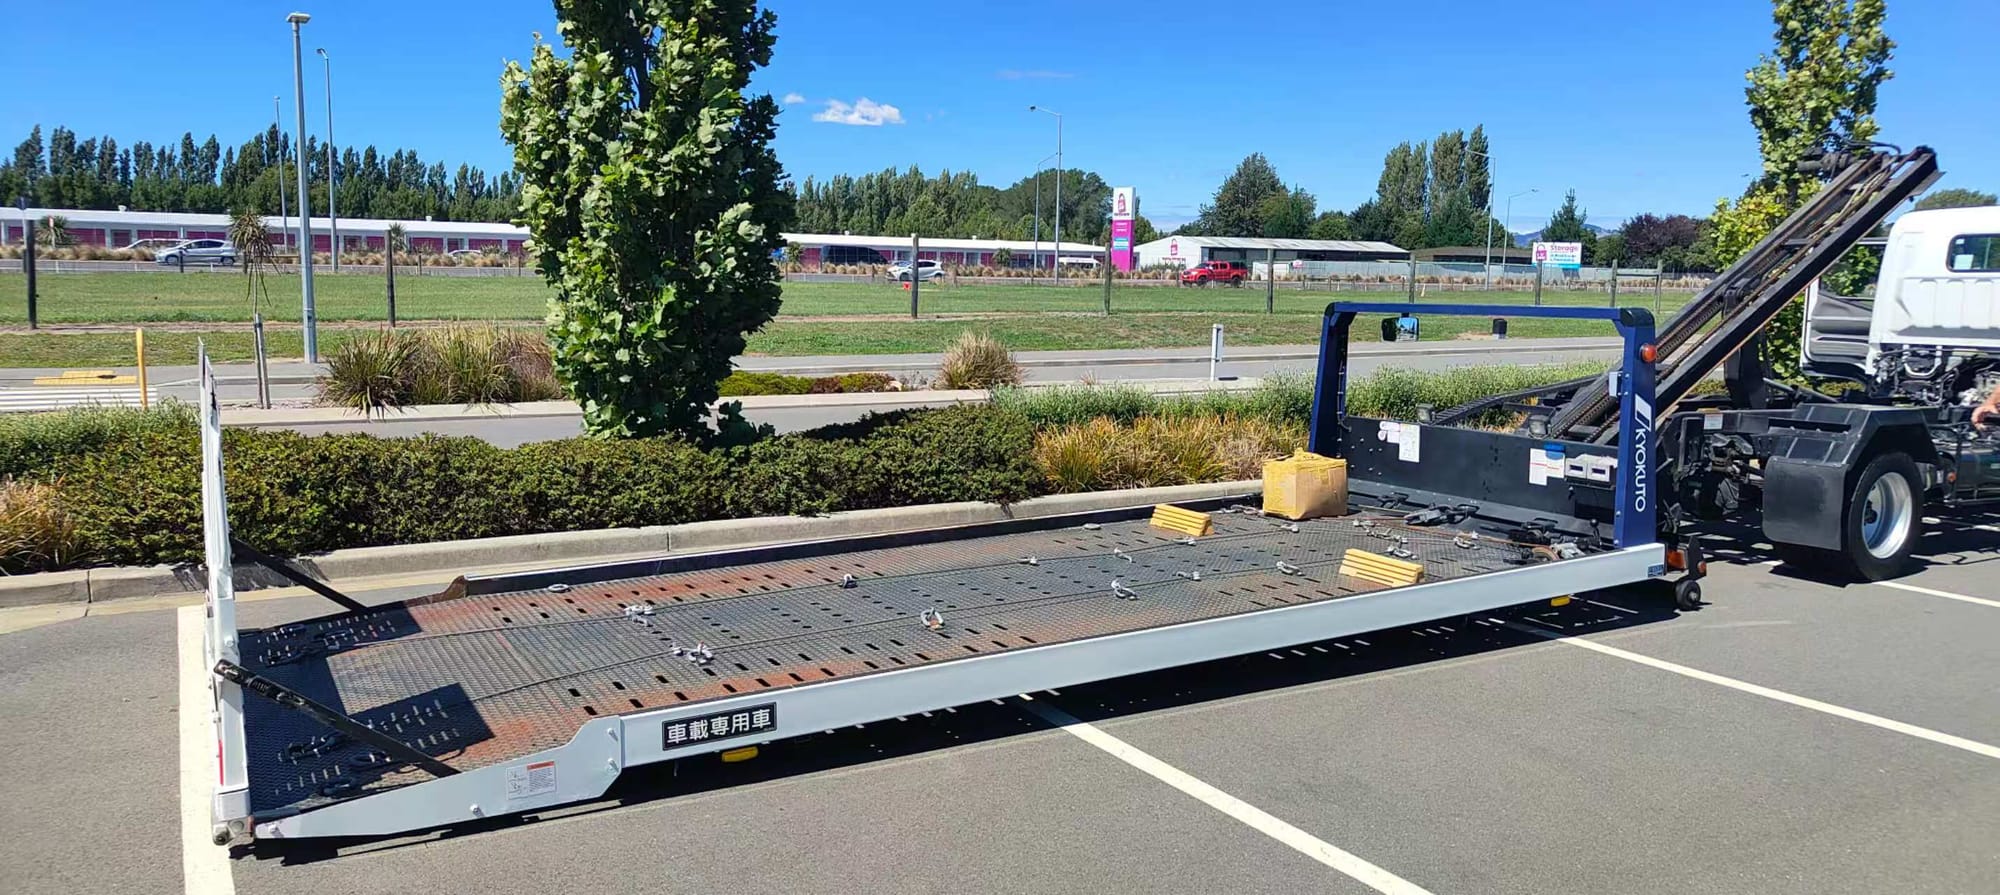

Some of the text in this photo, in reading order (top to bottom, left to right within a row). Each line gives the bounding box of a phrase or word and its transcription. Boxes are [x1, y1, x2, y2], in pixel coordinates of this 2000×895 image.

[1635, 428, 1646, 513] KYOKUTO
[667, 709, 771, 743] 車載専用車
